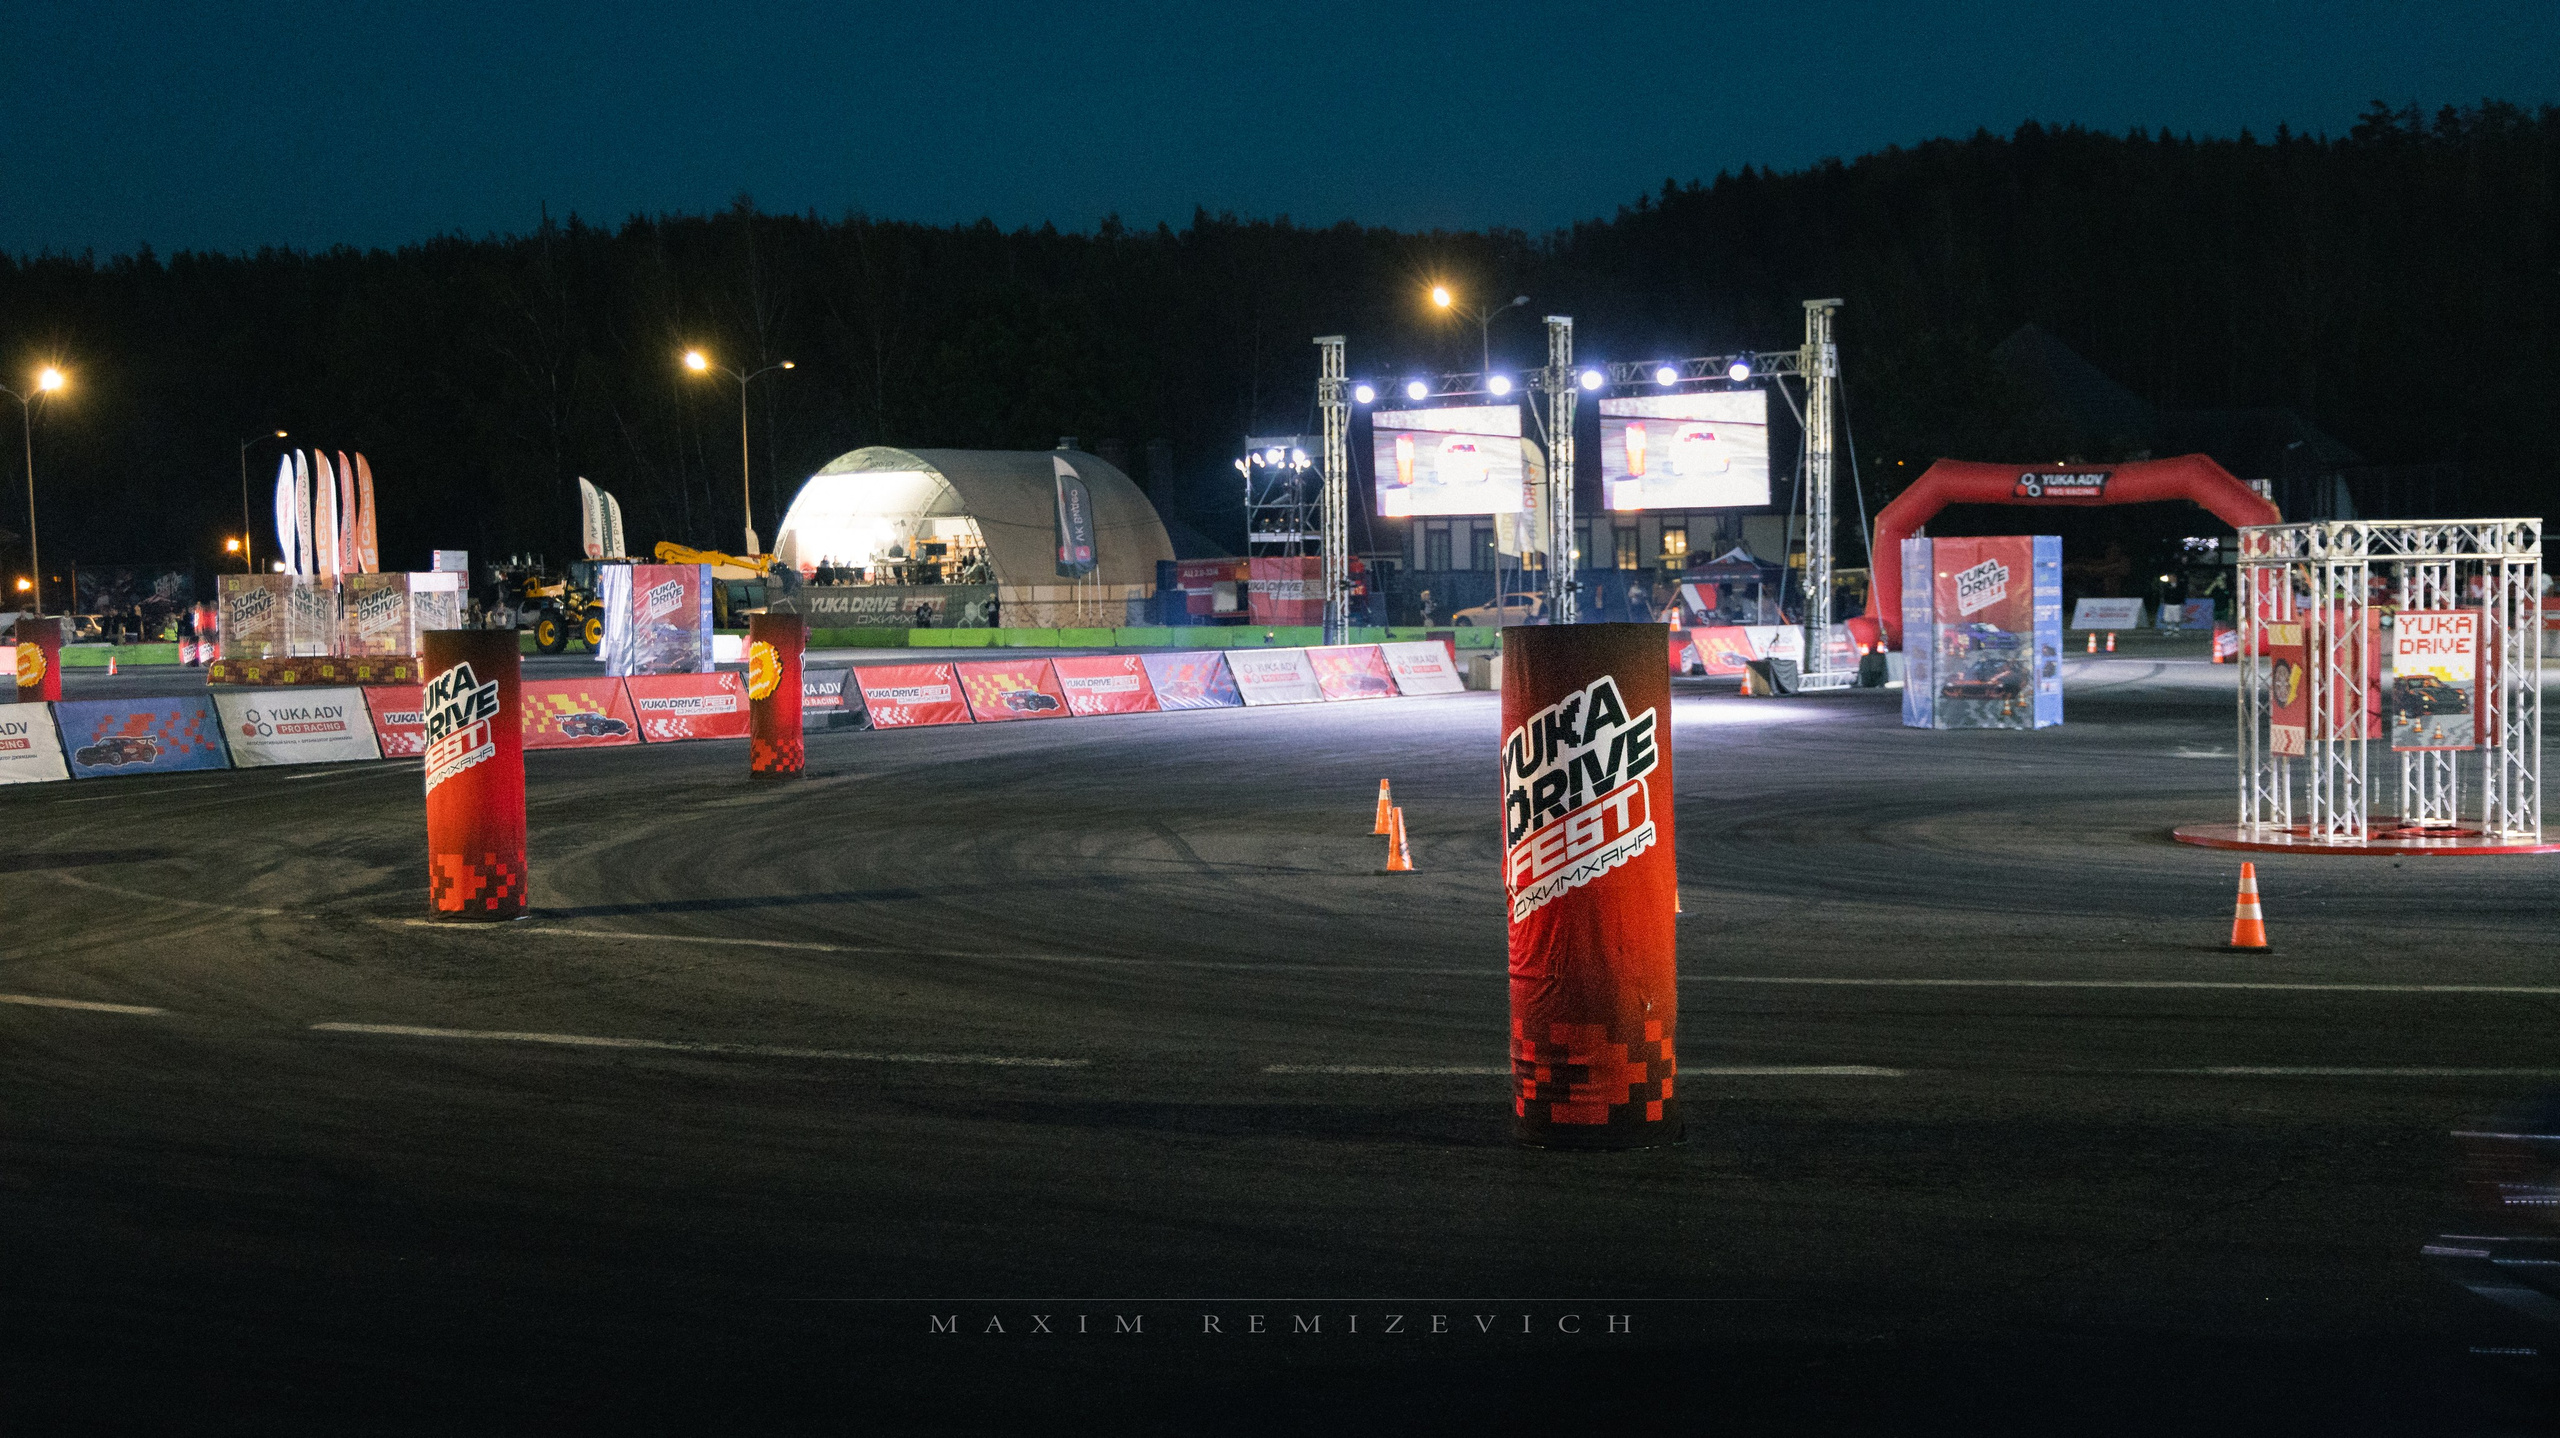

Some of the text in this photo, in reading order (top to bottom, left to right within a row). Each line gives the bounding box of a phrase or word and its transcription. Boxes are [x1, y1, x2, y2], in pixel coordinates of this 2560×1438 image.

[2042, 474, 2104, 485] YUKA ADV
[1957, 562, 1997, 585] YUKA
[1960, 569, 2006, 597] DRIVE
[231, 587, 267, 610] YUKA
[356, 586, 394, 609] YUKA
[649, 581, 676, 598] YUKA
[651, 587, 682, 606] DRIVE
[234, 595, 276, 622] DRIVE
[360, 594, 402, 621] DRIVE
[810, 597, 849, 613] YUKA
[850, 597, 898, 613] DRIVE
[2399, 616, 2472, 635] YUKA
[2399, 637, 2471, 655] DRIVE
[424, 665, 478, 717] UKA
[819, 683, 841, 694] ADV
[1065, 679, 1086, 688] YUKA
[1087, 678, 1111, 687] DRIVE
[867, 689, 891, 698] YUKA
[891, 688, 919, 698] DRIVE
[269, 705, 343, 721] YUKA ADV
[640, 700, 668, 709] YUKA
[669, 698, 702, 708] DRIVE
[281, 722, 341, 734] PRO RACING
[385, 713, 418, 724] YUKA
[1502, 681, 1627, 791] YUKA
[1506, 713, 1656, 849] DRIVE
[1511, 782, 1640, 894] FEST
